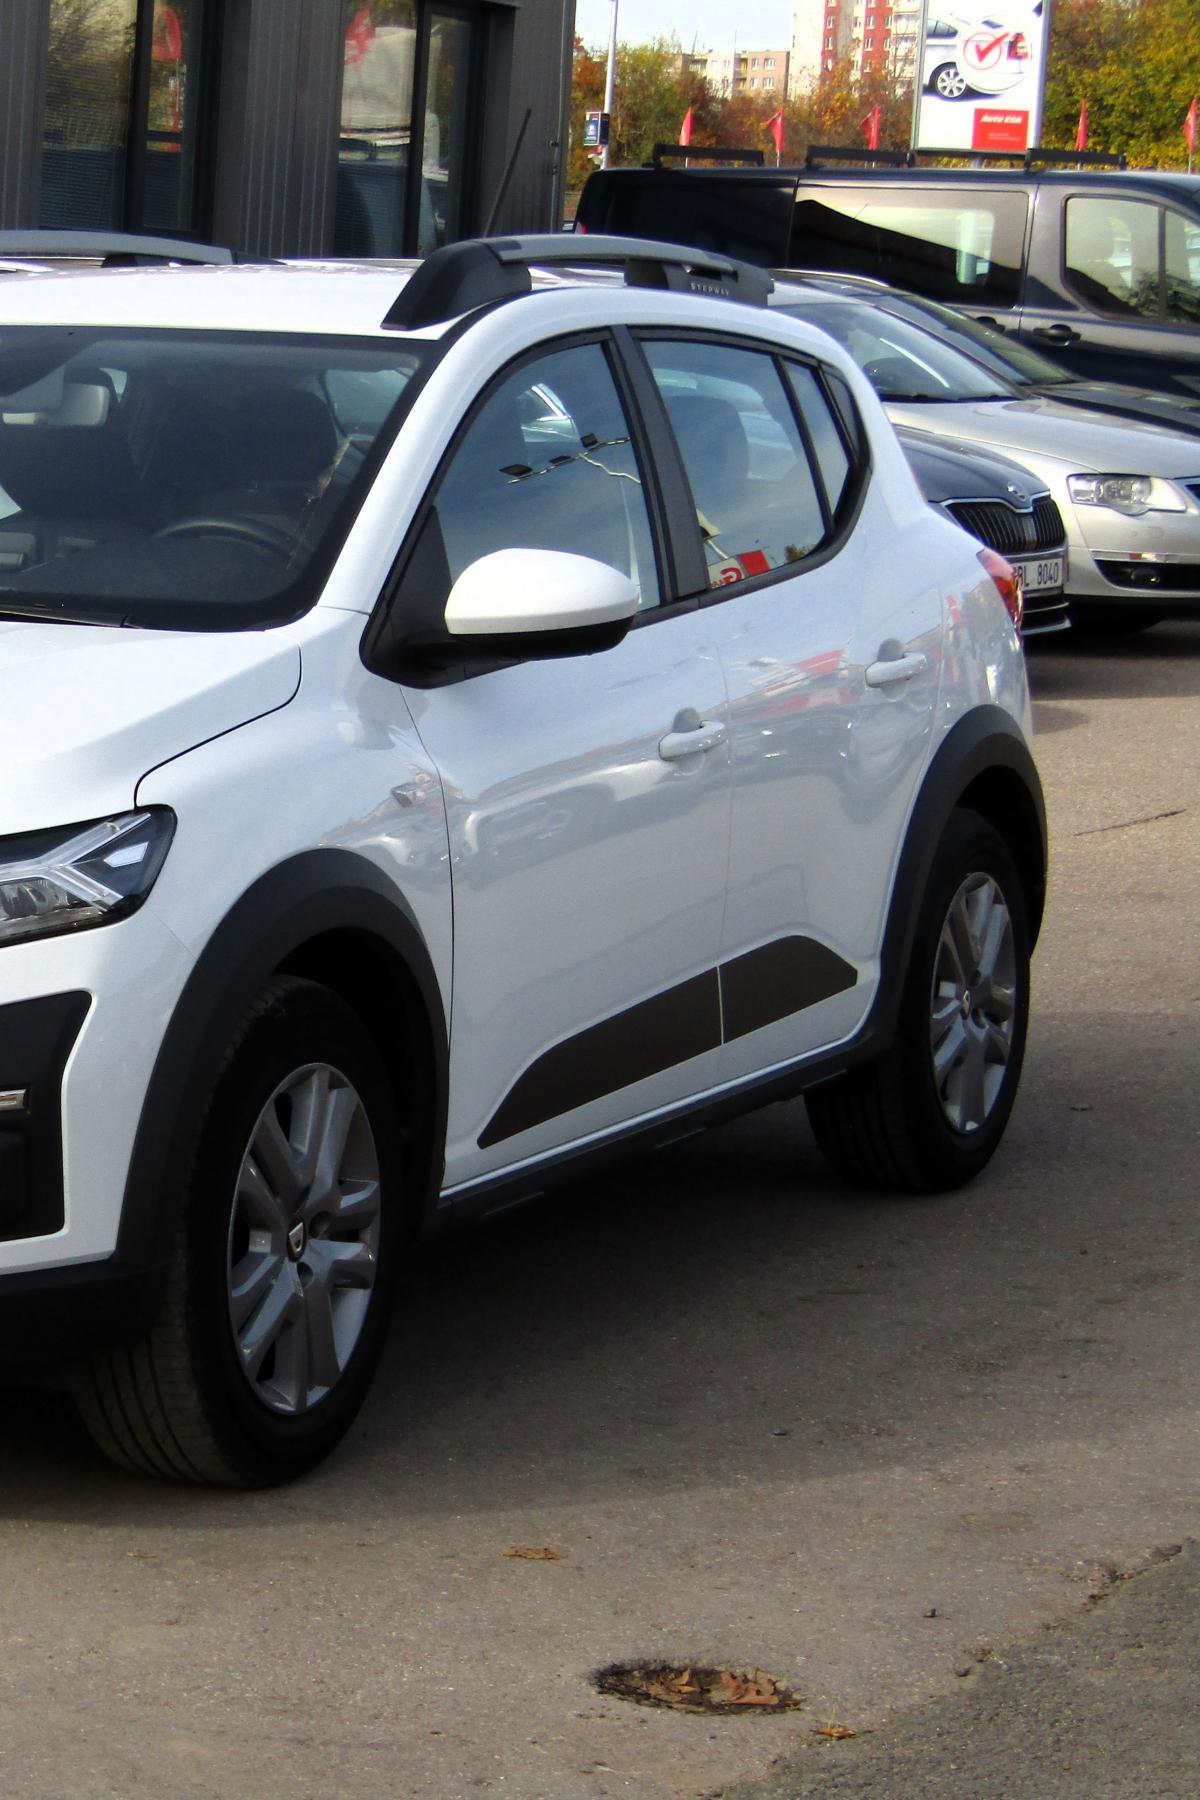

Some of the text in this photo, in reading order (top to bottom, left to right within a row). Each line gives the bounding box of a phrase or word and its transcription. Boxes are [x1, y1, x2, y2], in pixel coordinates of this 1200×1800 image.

[980, 115, 1003, 123] Auto
[690, 282, 729, 296] STEPWAY
[1037, 562, 1059, 586] 8040
